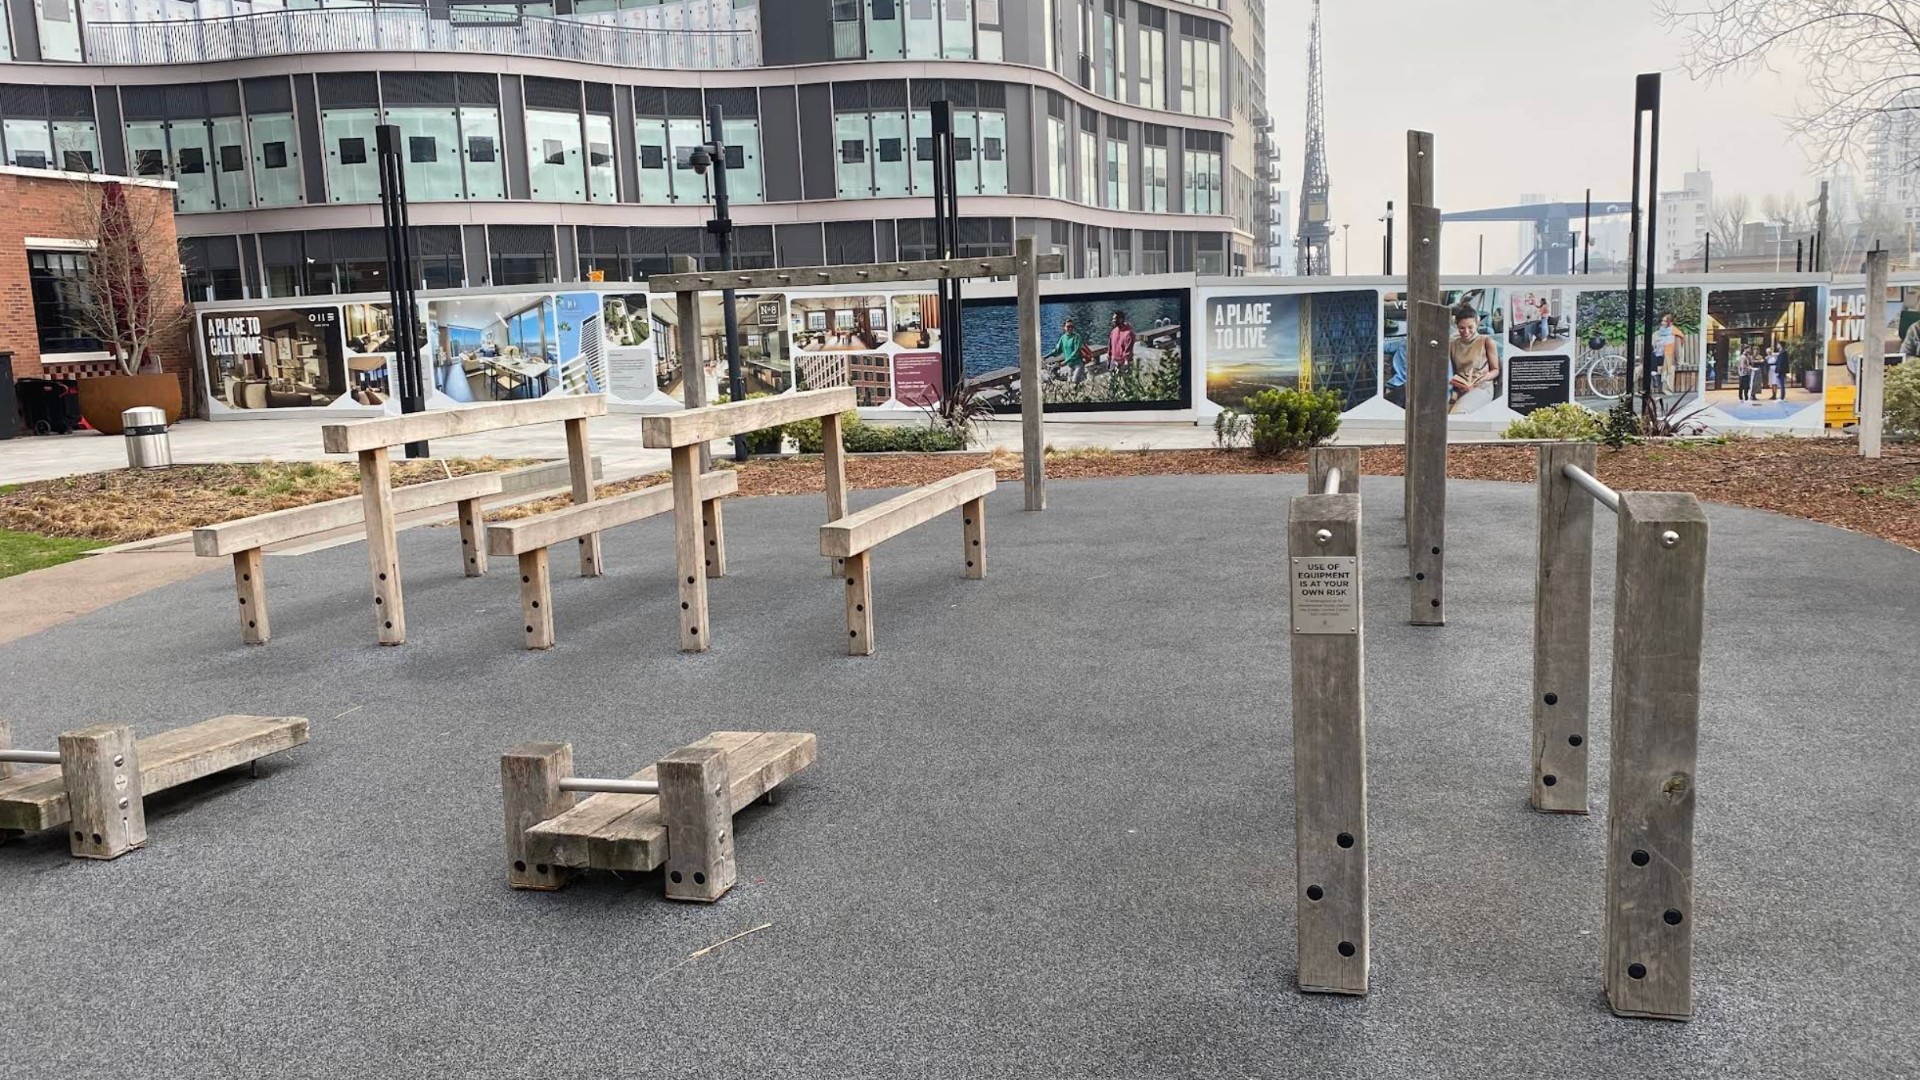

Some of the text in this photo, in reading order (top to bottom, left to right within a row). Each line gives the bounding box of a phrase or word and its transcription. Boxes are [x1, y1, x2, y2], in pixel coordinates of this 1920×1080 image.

[1214, 302, 1272, 326] A PLACE
[1829, 294, 1866, 317] PLAC
[208, 316, 261, 337] A PLACE TO
[1836, 319, 1865, 341] LIV
[209, 336, 263, 356] CALL HOME
[1214, 326, 1267, 350] TO LIVE
[1307, 563, 1340, 571] USE OF
